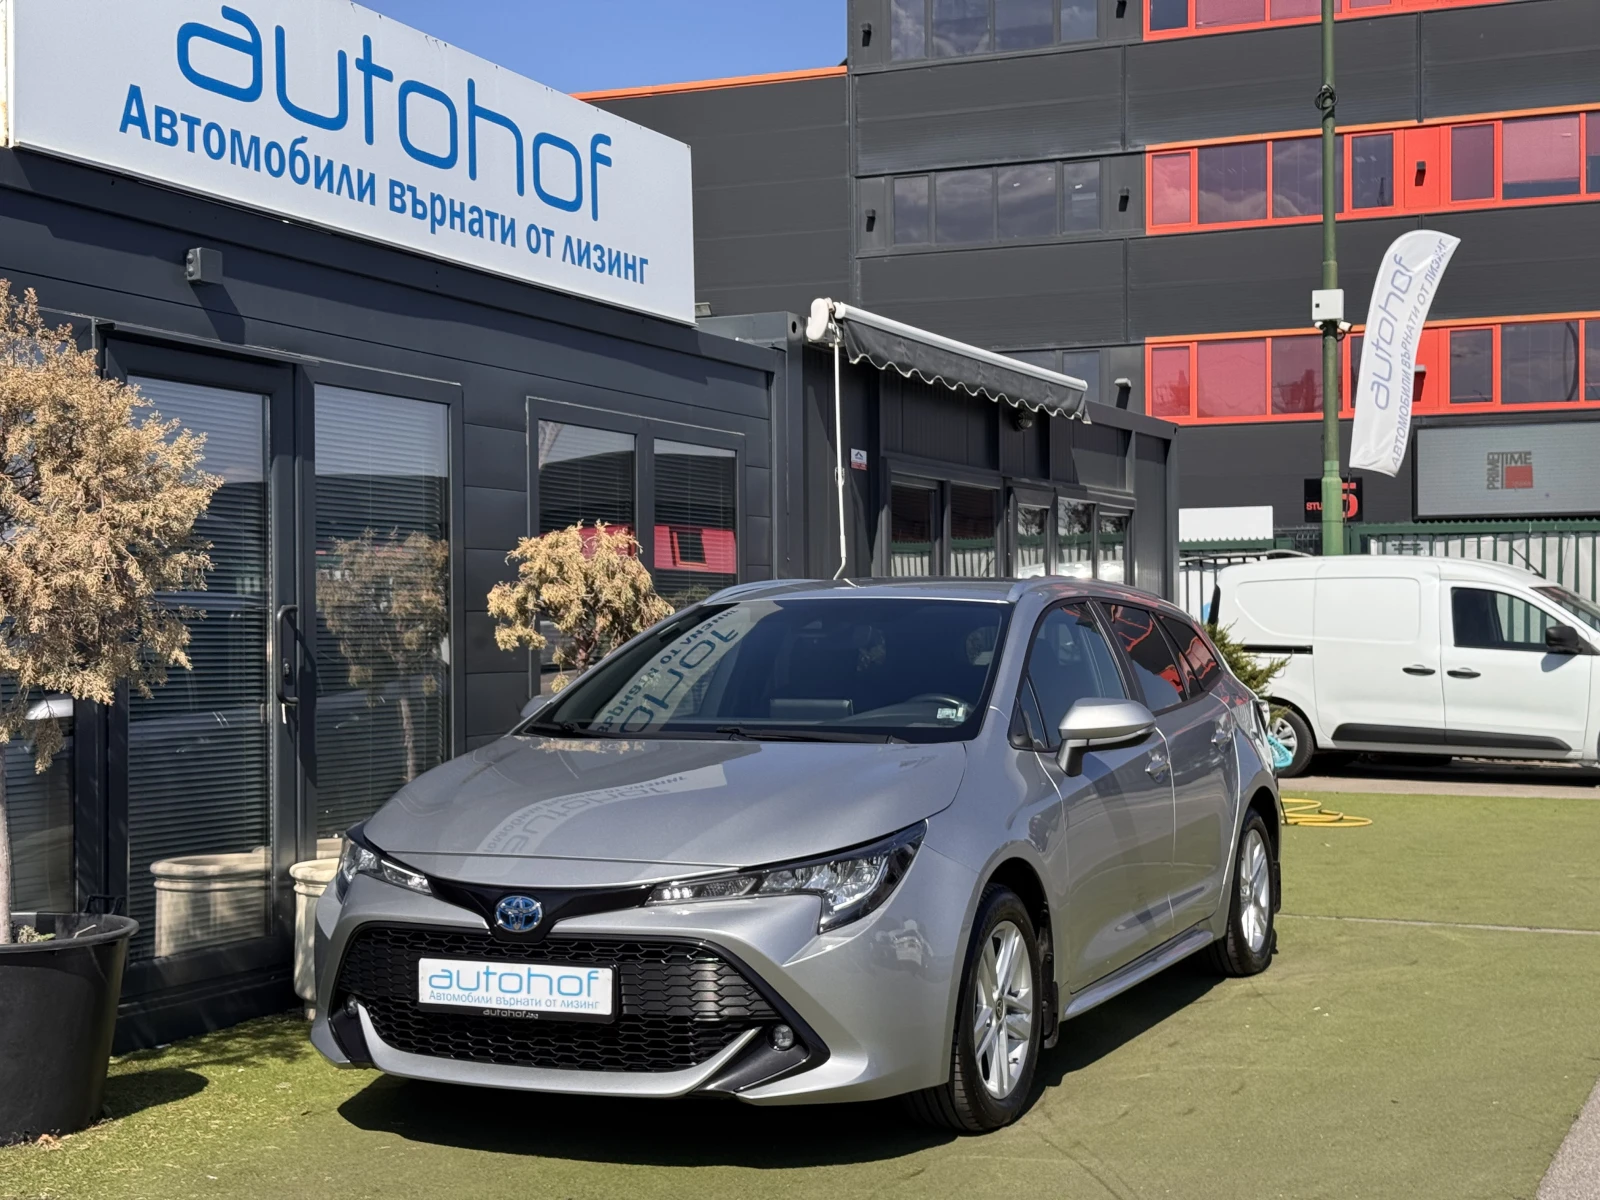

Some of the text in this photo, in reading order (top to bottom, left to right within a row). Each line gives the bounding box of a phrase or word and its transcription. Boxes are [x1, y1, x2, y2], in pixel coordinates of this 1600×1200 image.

[176, 4, 613, 221] autohof
[119, 83, 649, 284] Автомобили върнати от лизинг
[1417, 283, 1429, 305] ОТ
[1370, 253, 1414, 411] autohof
[1400, 305, 1420, 369] ВЪРНАТИ
[1392, 368, 1411, 468] АВТОМОБИЛИ
[1487, 452, 1500, 489] PRIME
[1306, 502, 1323, 510] STU
[428, 965, 599, 997] autohof
[428, 989, 600, 1010] Автомобили върнати от лизинг
